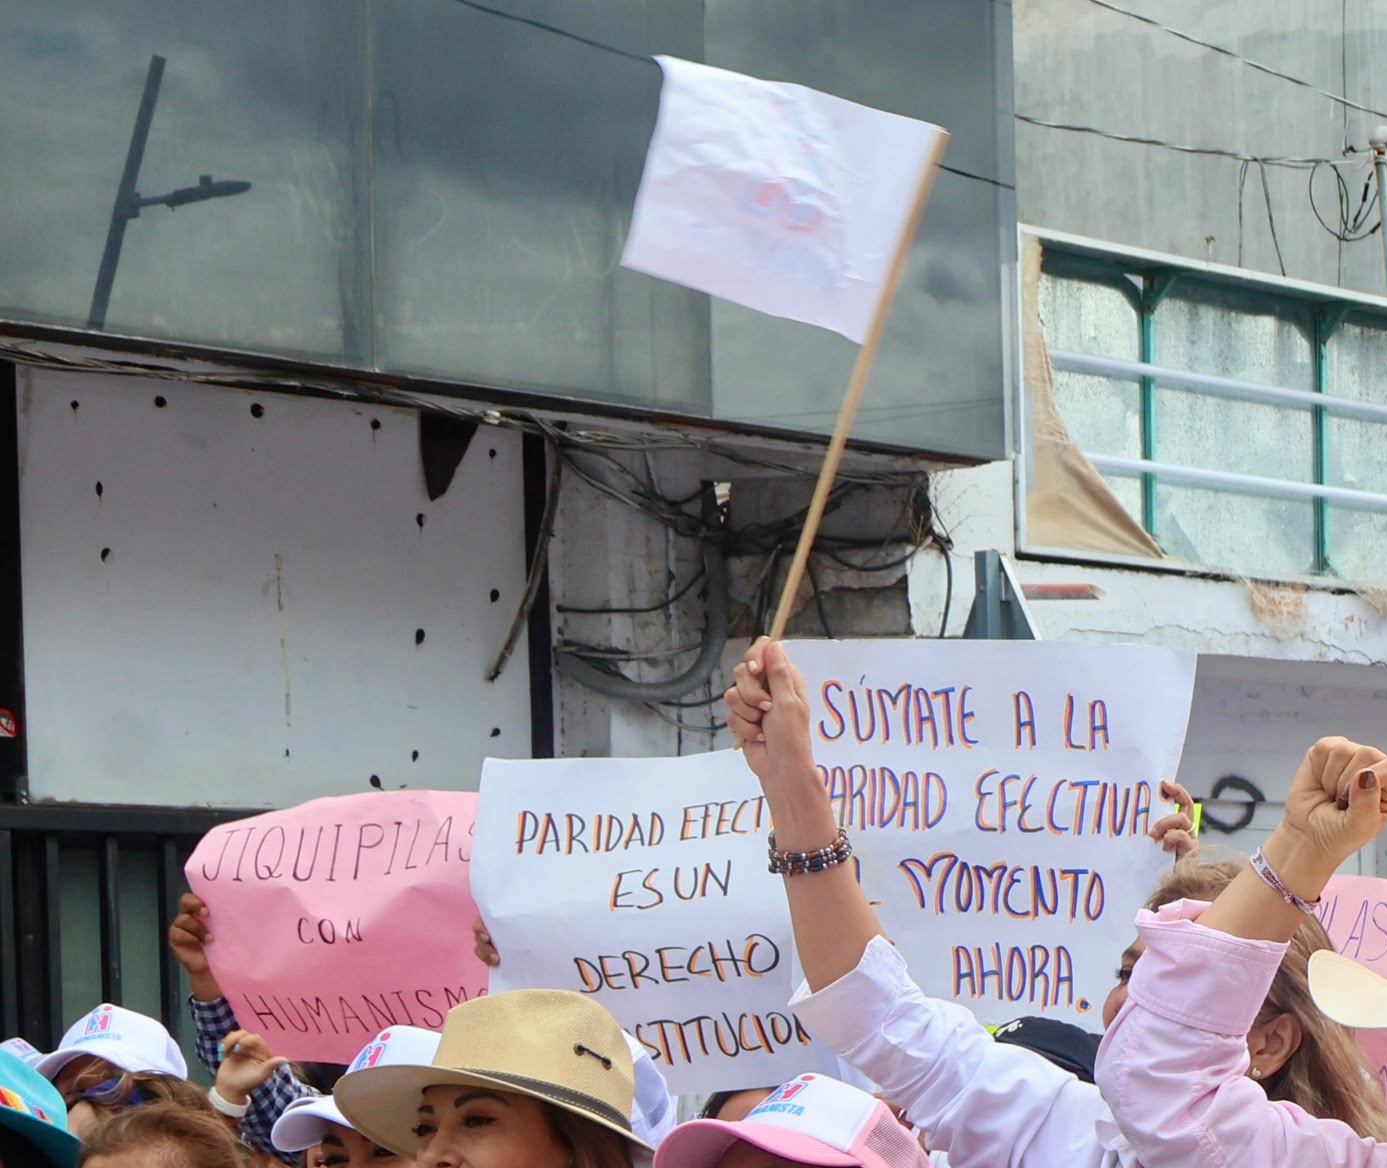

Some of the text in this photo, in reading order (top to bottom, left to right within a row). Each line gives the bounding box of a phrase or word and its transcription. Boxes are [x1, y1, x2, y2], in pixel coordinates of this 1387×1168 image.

[817, 674, 1111, 752] SÚMATE A LA
[514, 795, 774, 855] PARIDAD EFECT
[974, 768, 1153, 838] EFECTIVA
[610, 859, 732, 913] ES UN
[896, 851, 1106, 924] MOMENTO
[296, 917, 363, 944] CON
[572, 932, 781, 994] DERECHO
[951, 942, 1092, 1013] AHORA.
[624, 1010, 813, 1067] STITUCION
